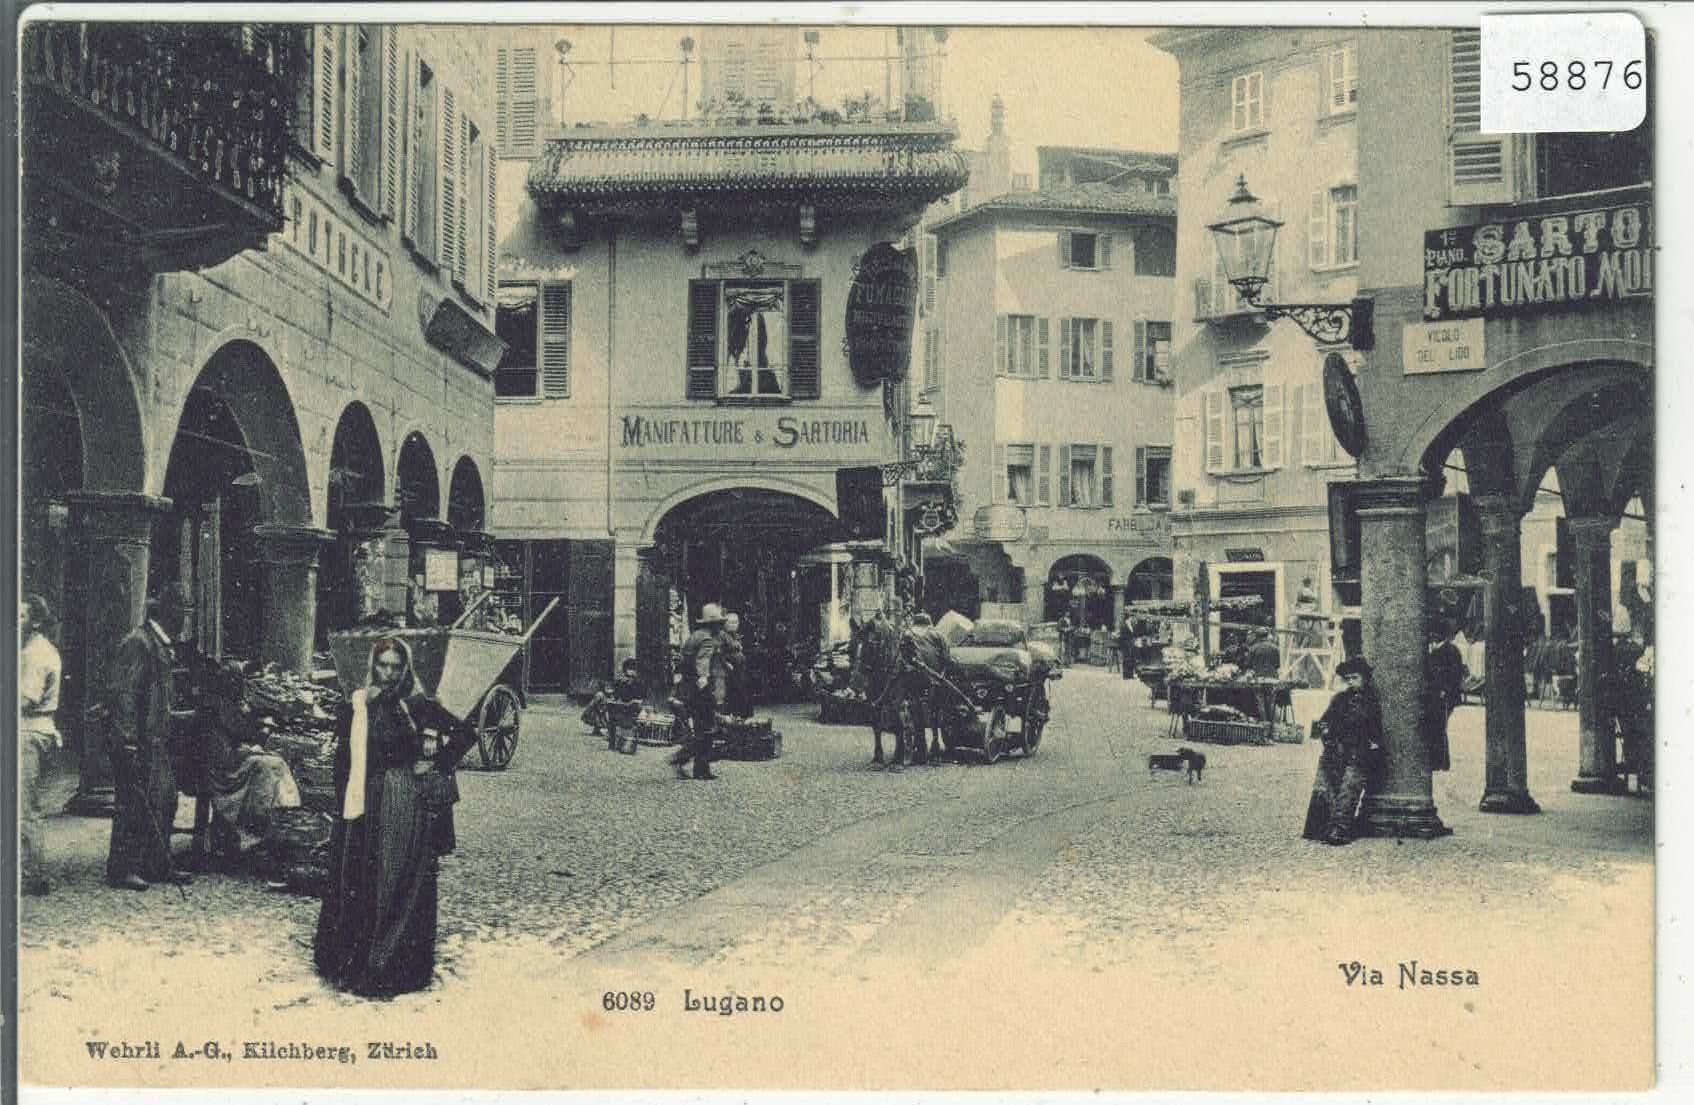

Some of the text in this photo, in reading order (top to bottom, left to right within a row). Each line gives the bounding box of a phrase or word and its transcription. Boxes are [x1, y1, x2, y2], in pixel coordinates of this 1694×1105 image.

[291, 194, 385, 301] POTHEKE
[1474, 206, 1653, 265] SARTO
[1424, 255, 1586, 319] FORTUNATO
[1427, 326, 1461, 343] VICOLO
[754, 430, 764, 441] &
